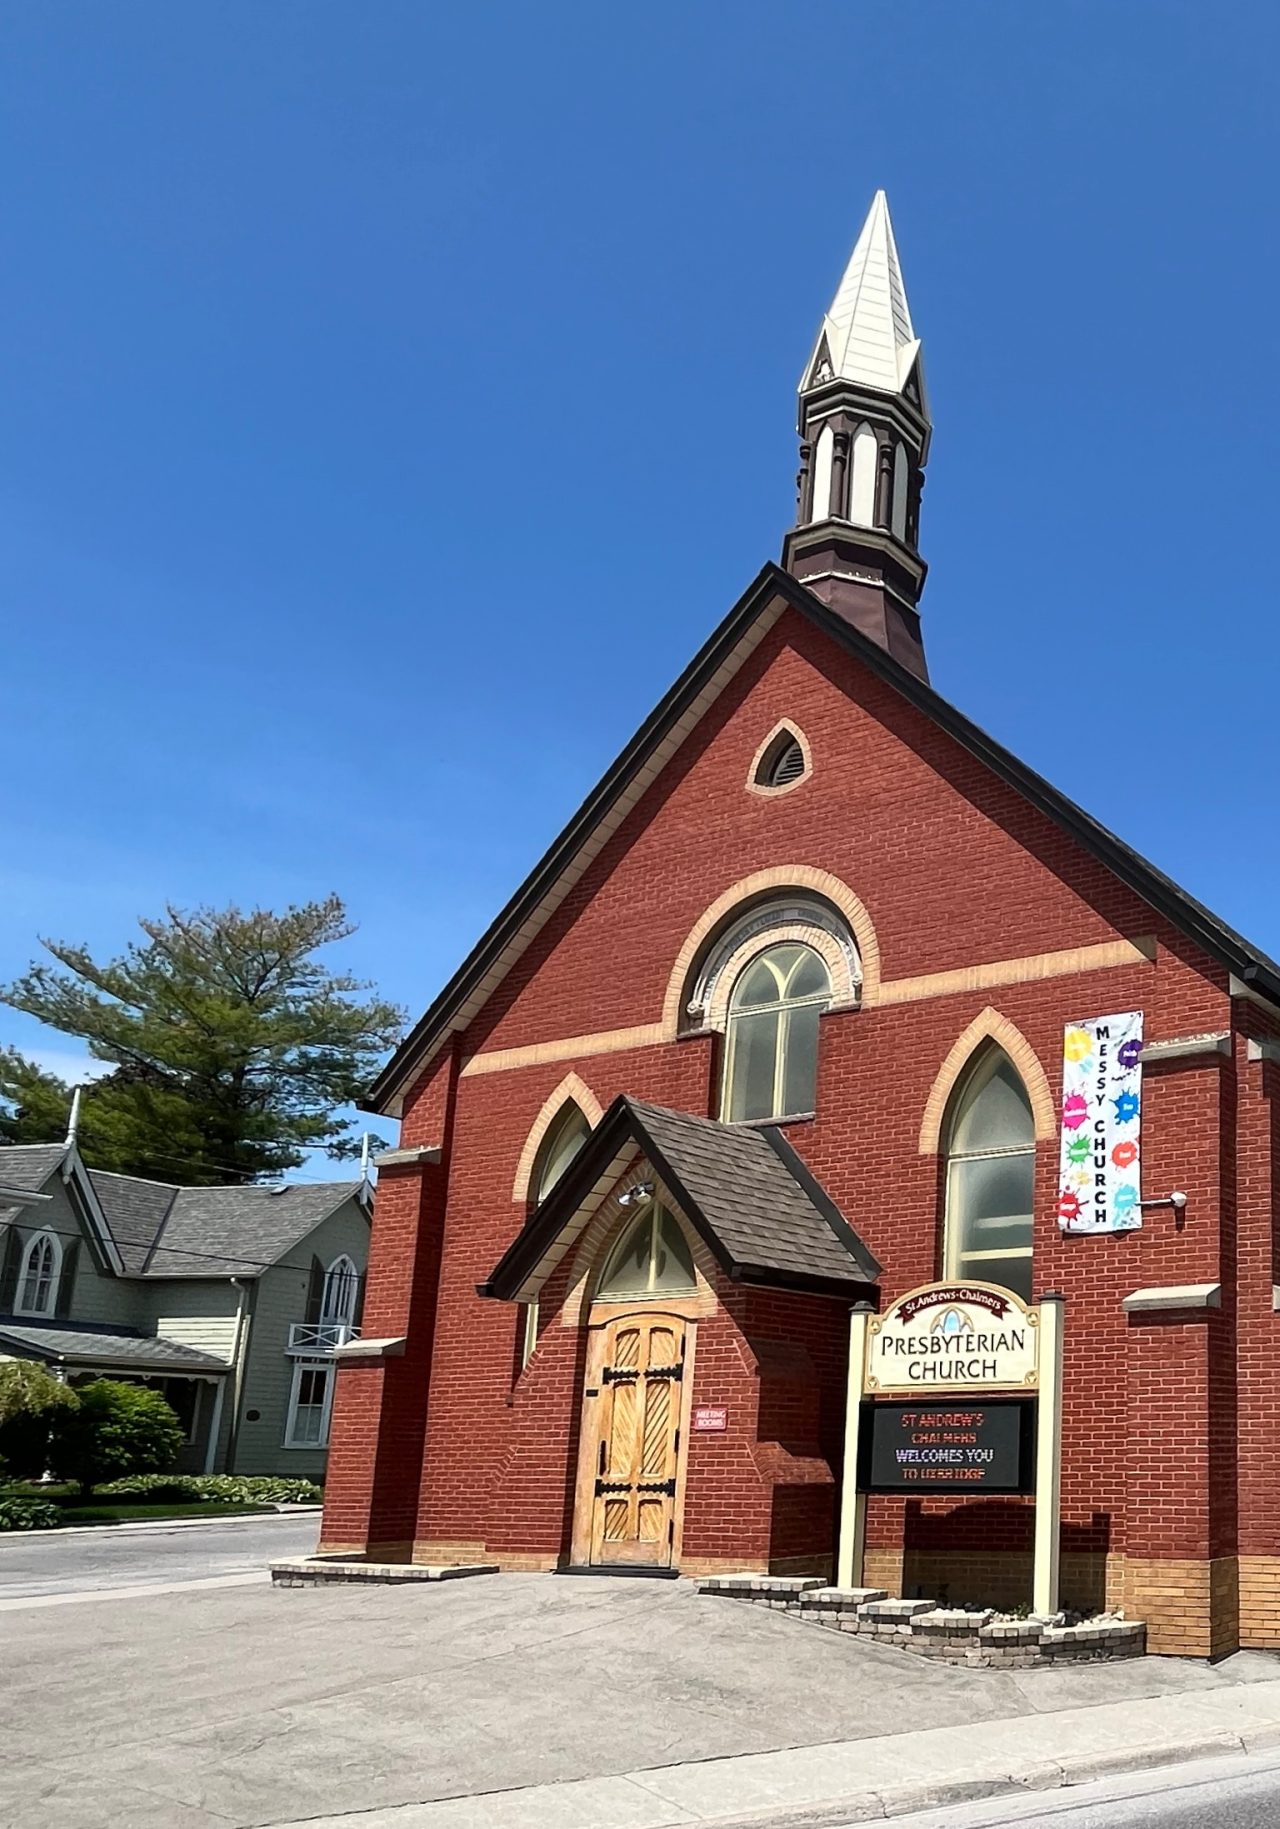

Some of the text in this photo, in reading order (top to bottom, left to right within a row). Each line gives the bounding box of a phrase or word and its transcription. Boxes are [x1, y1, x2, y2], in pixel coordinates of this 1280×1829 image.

[1094, 1026, 1110, 1223] MESSY CHURCH
[882, 1329, 1025, 1356] PRESBYTERIAN
[908, 1359, 997, 1380] CHURCH
[902, 1414, 917, 1427] ST
[896, 1448, 994, 1463] WELCOMES YOU
[902, 1468, 918, 1479] TO
